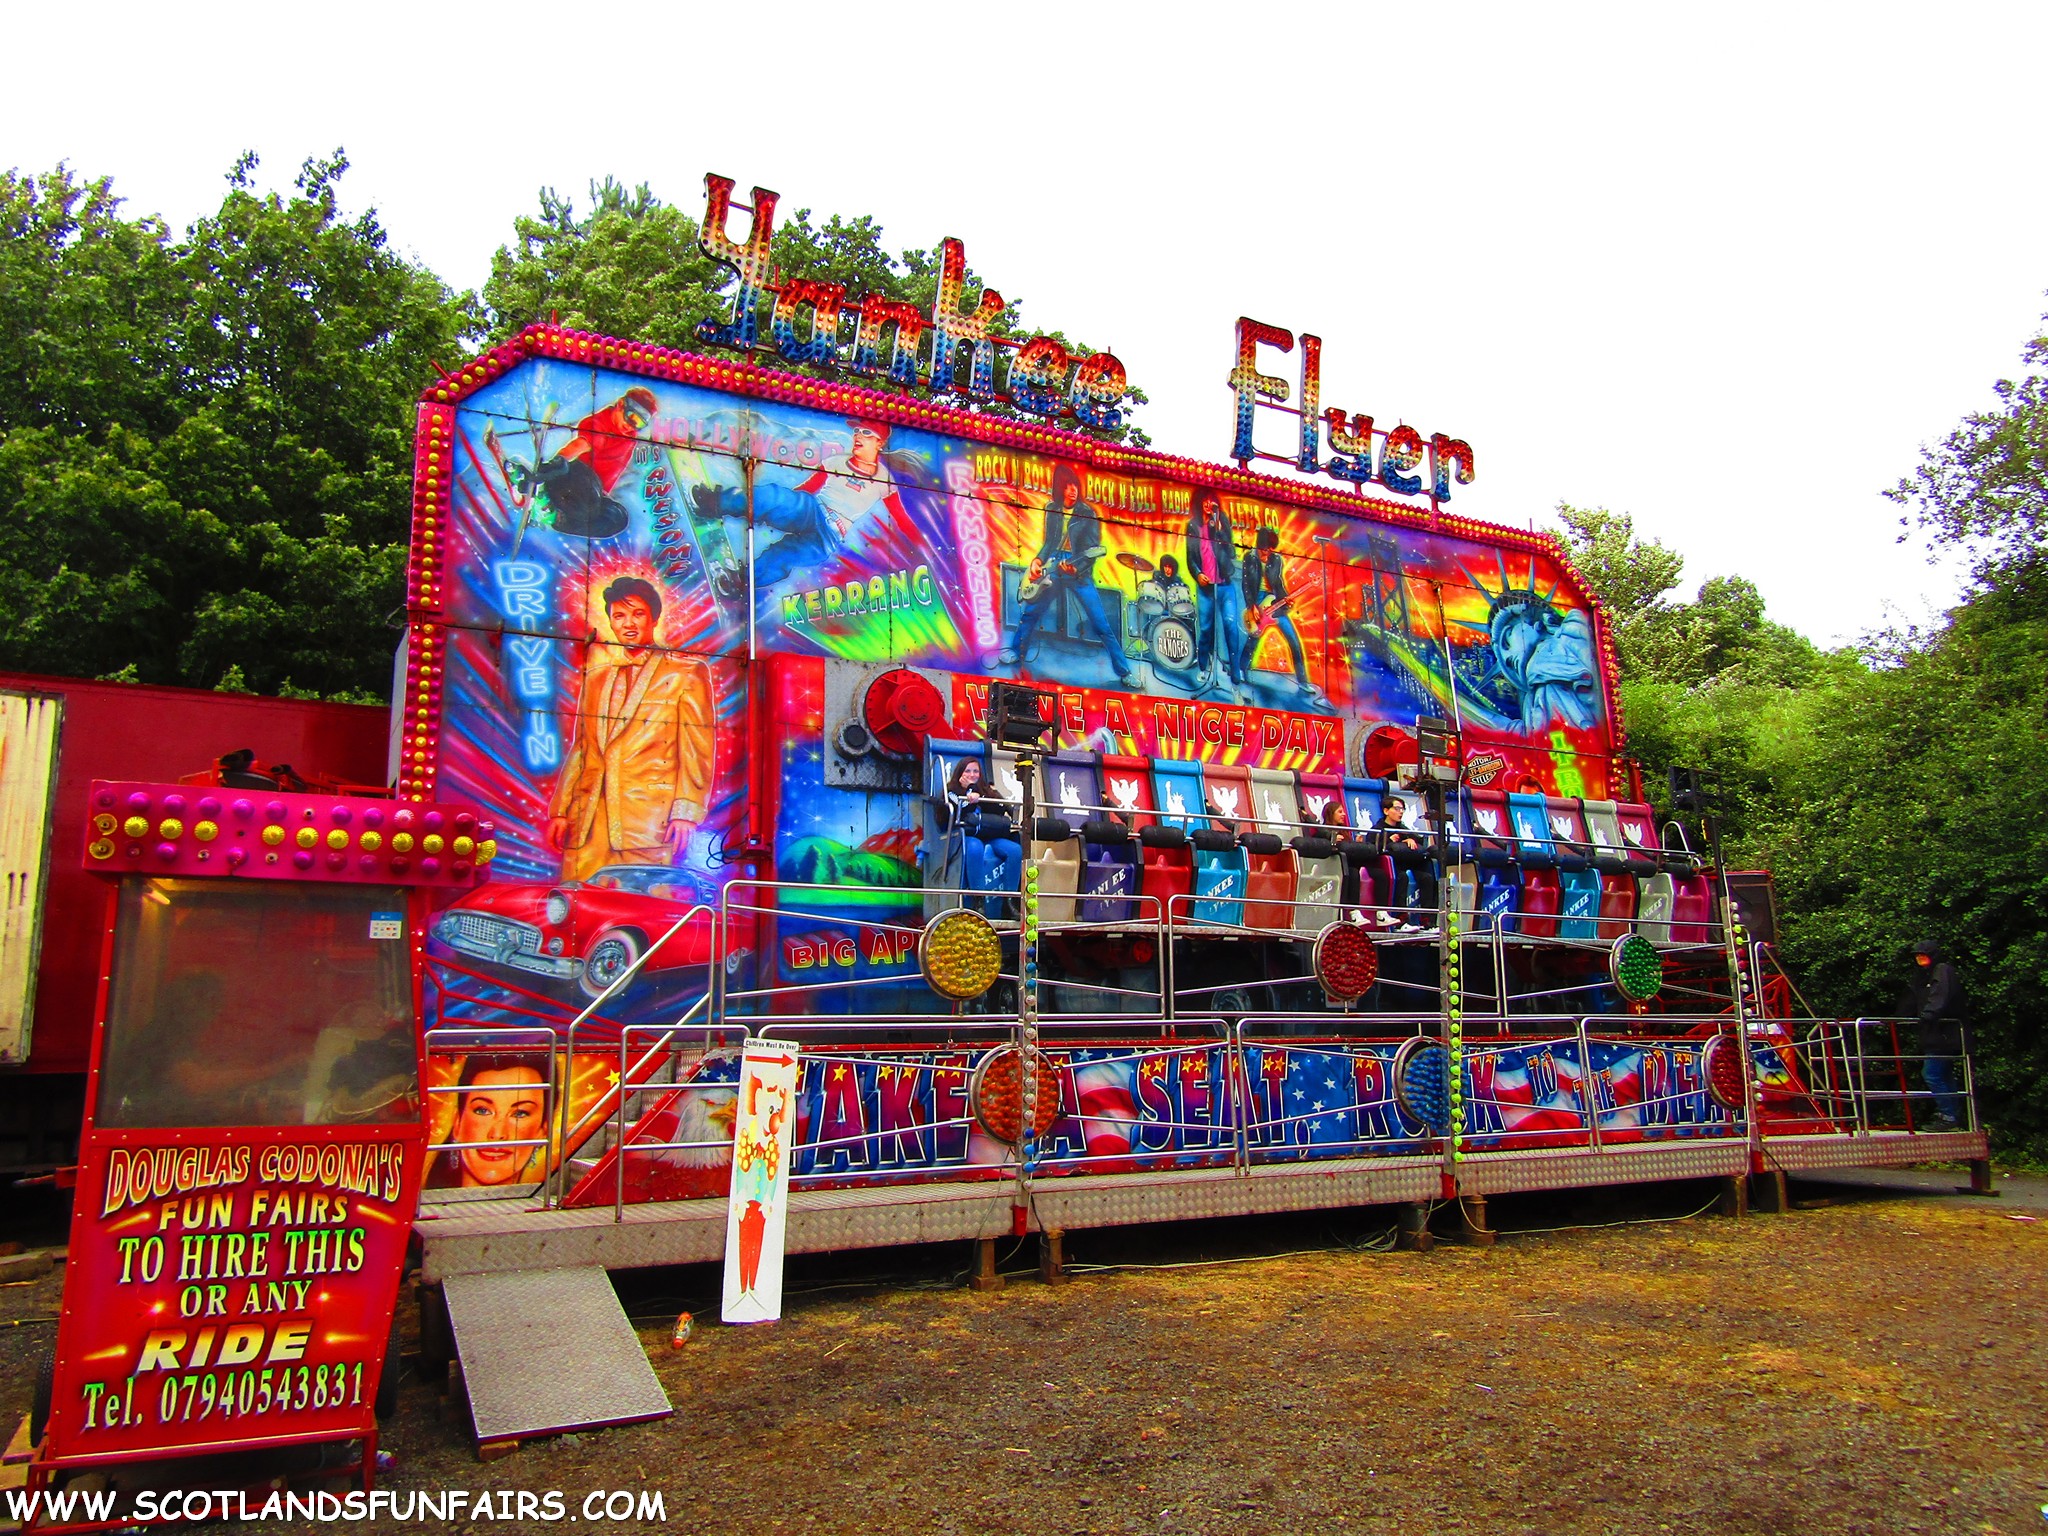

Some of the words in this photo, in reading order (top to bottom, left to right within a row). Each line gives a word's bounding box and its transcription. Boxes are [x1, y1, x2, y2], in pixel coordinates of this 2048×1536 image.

[694, 172, 1128, 432] Yankee
[1228, 316, 1475, 503] Flyer
[652, 415, 846, 467] HOLLYWOOD
[975, 455, 1008, 485] ROCK
[1085, 474, 1114, 509] ROCK
[1162, 489, 1190, 516] RADIO
[644, 466, 692, 578] AWESOME
[1264, 508, 1279, 534] GO
[945, 461, 999, 648] RAMONES
[783, 564, 933, 625] KERRANG
[1164, 629, 1182, 639] THE
[499, 562, 549, 696] DRIVE
[526, 709, 556, 766] IN
[966, 685, 1085, 732] HVE
[1104, 699, 1131, 738] A
[1154, 703, 1244, 747] NICE
[1262, 716, 1334, 755] DAY
[792, 938, 857, 968] BIG
[1526, 1049, 1558, 1103] TO
[103, 1146, 251, 1217] DOUGLAS
[259, 1143, 404, 1203] CODONA'S
[158, 1193, 232, 1230] FUN
[250, 1190, 348, 1227] FAIRS
[118, 1236, 164, 1284] TO
[179, 1232, 270, 1282] HIRE
[284, 1228, 366, 1274] THIS
[180, 1285, 227, 1318] OR
[241, 1280, 312, 1313] ANY
[137, 1320, 314, 1372] RIDE
[83, 1381, 142, 1430] Tel.
[160, 1361, 364, 1423] 07940543831
